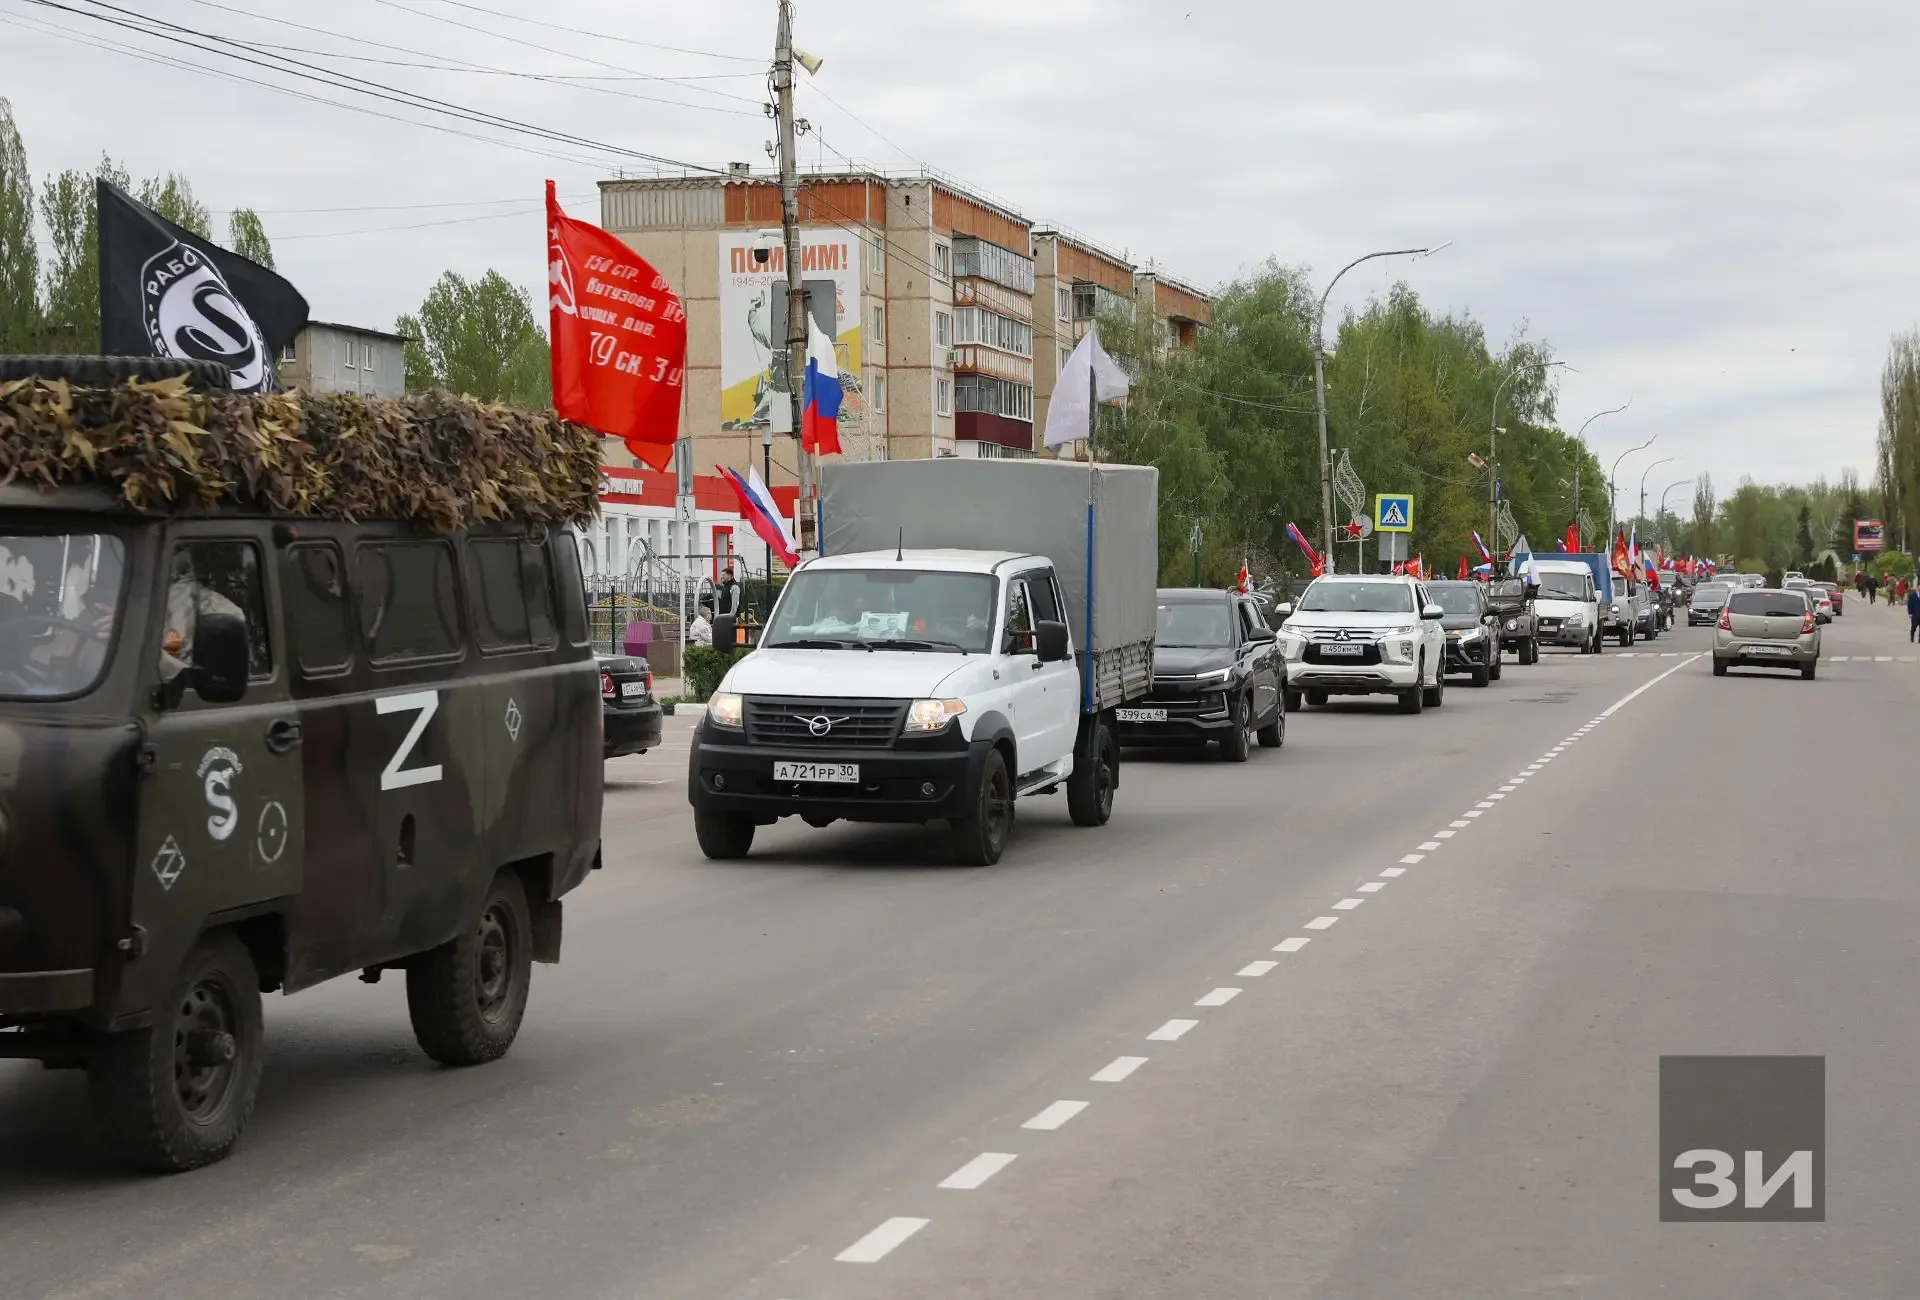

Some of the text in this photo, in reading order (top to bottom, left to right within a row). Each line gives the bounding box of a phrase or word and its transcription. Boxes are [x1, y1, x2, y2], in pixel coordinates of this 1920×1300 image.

[584, 255, 614, 273] 150
[731, 244, 847, 273] ПОМИМ!
[589, 331, 618, 366] 79
[375, 690, 443, 791] Z
[780, 764, 854, 780] А721РР 30
